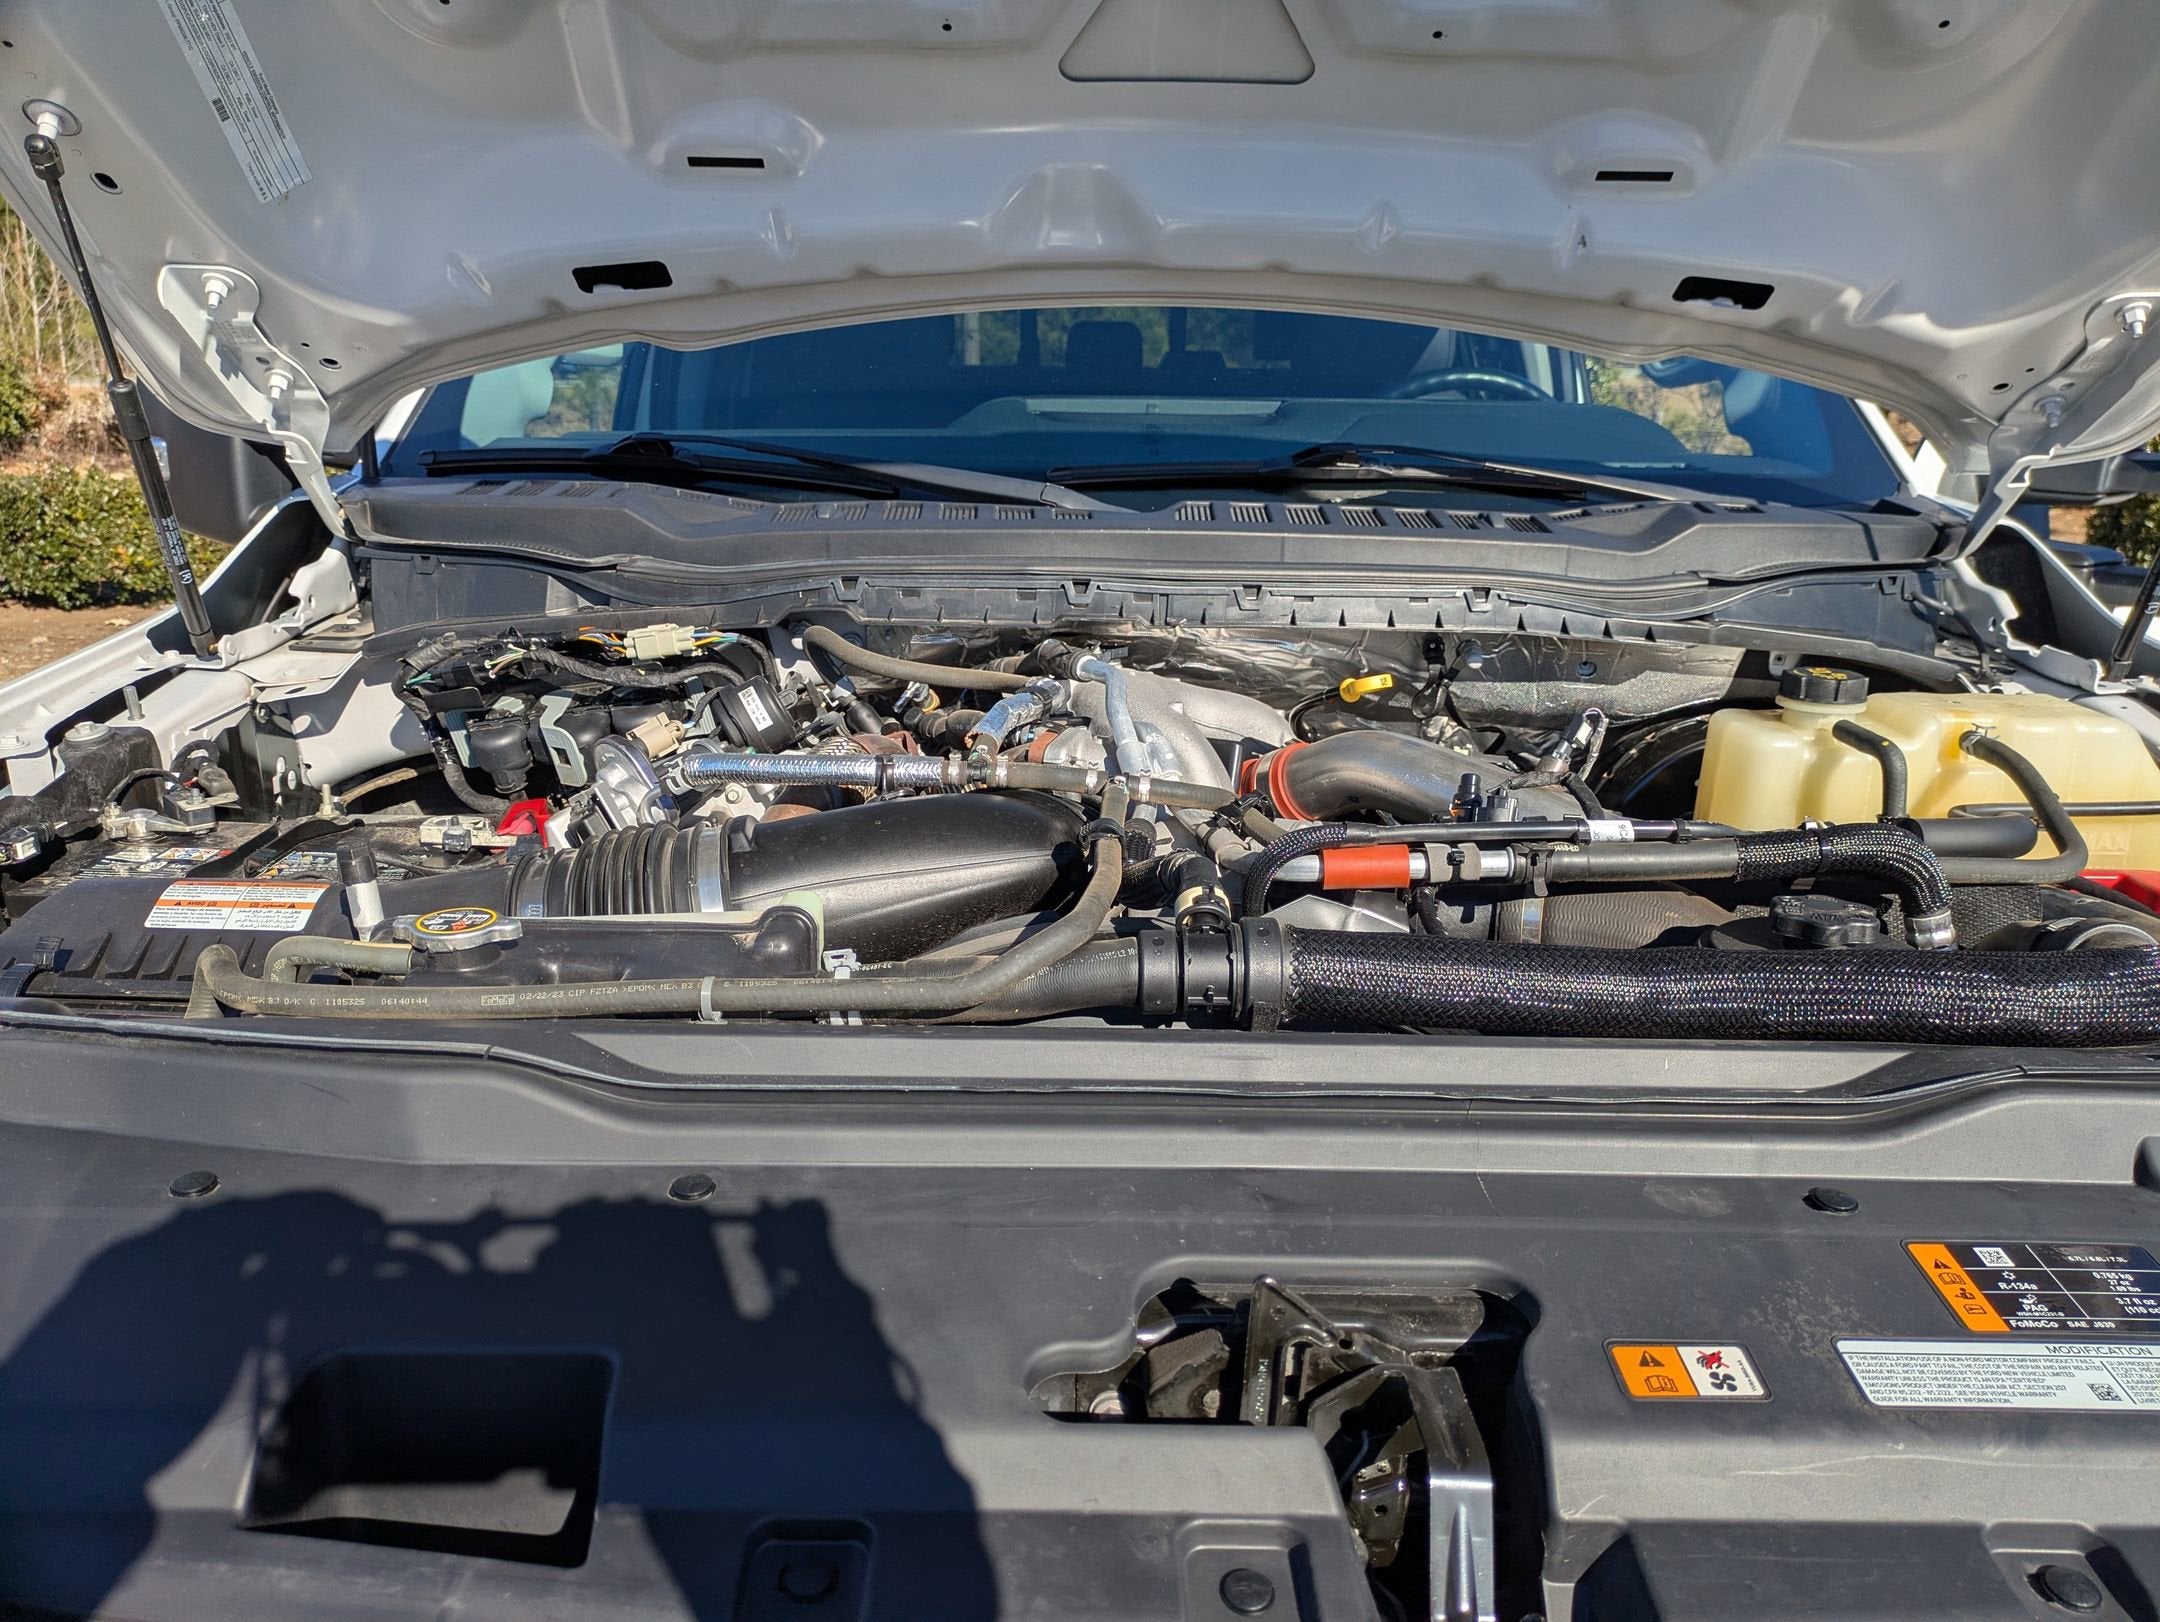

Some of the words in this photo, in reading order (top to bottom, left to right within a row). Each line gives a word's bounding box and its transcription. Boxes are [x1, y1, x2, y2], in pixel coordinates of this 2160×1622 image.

[1998, 1282, 2038, 1290] R-134a
[2022, 1304, 2048, 1312] PAG
[2124, 1306, 2148, 1315] (110
[2009, 1320, 2059, 1328] FoMoCo
[2045, 1345, 2153, 1357] MODIFICATION
